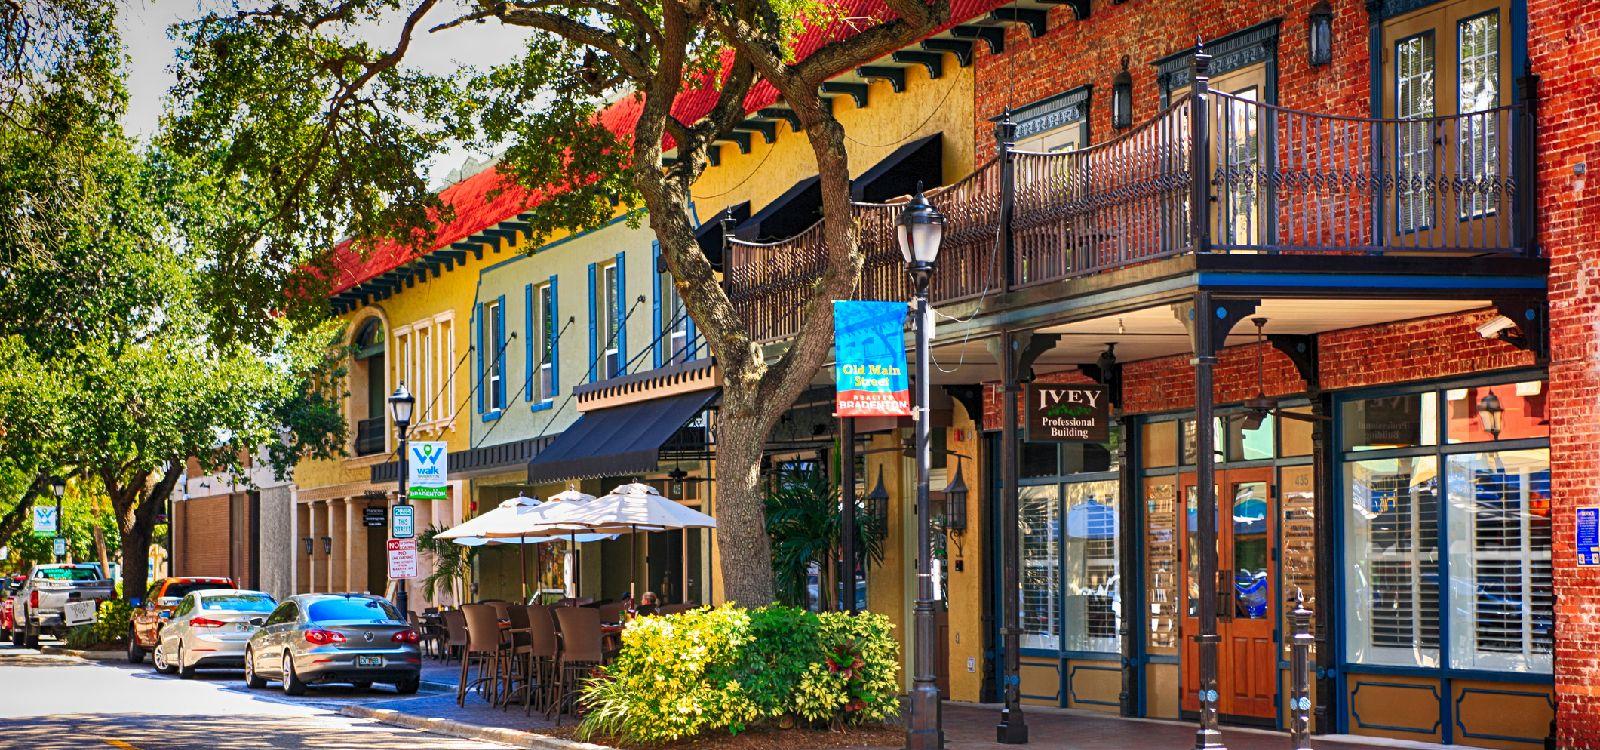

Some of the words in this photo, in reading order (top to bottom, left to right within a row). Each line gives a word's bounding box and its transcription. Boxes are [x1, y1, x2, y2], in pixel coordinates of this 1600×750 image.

[842, 364, 865, 375] Old
[868, 364, 901, 375] Main
[854, 376, 889, 387] Street
[1039, 389, 1101, 410] IVEY
[839, 401, 907, 409] BRADENTON
[1042, 416, 1095, 426] Professional
[1051, 427, 1089, 439] Building
[417, 466, 439, 475] walk
[388, 542, 399, 550] NO
